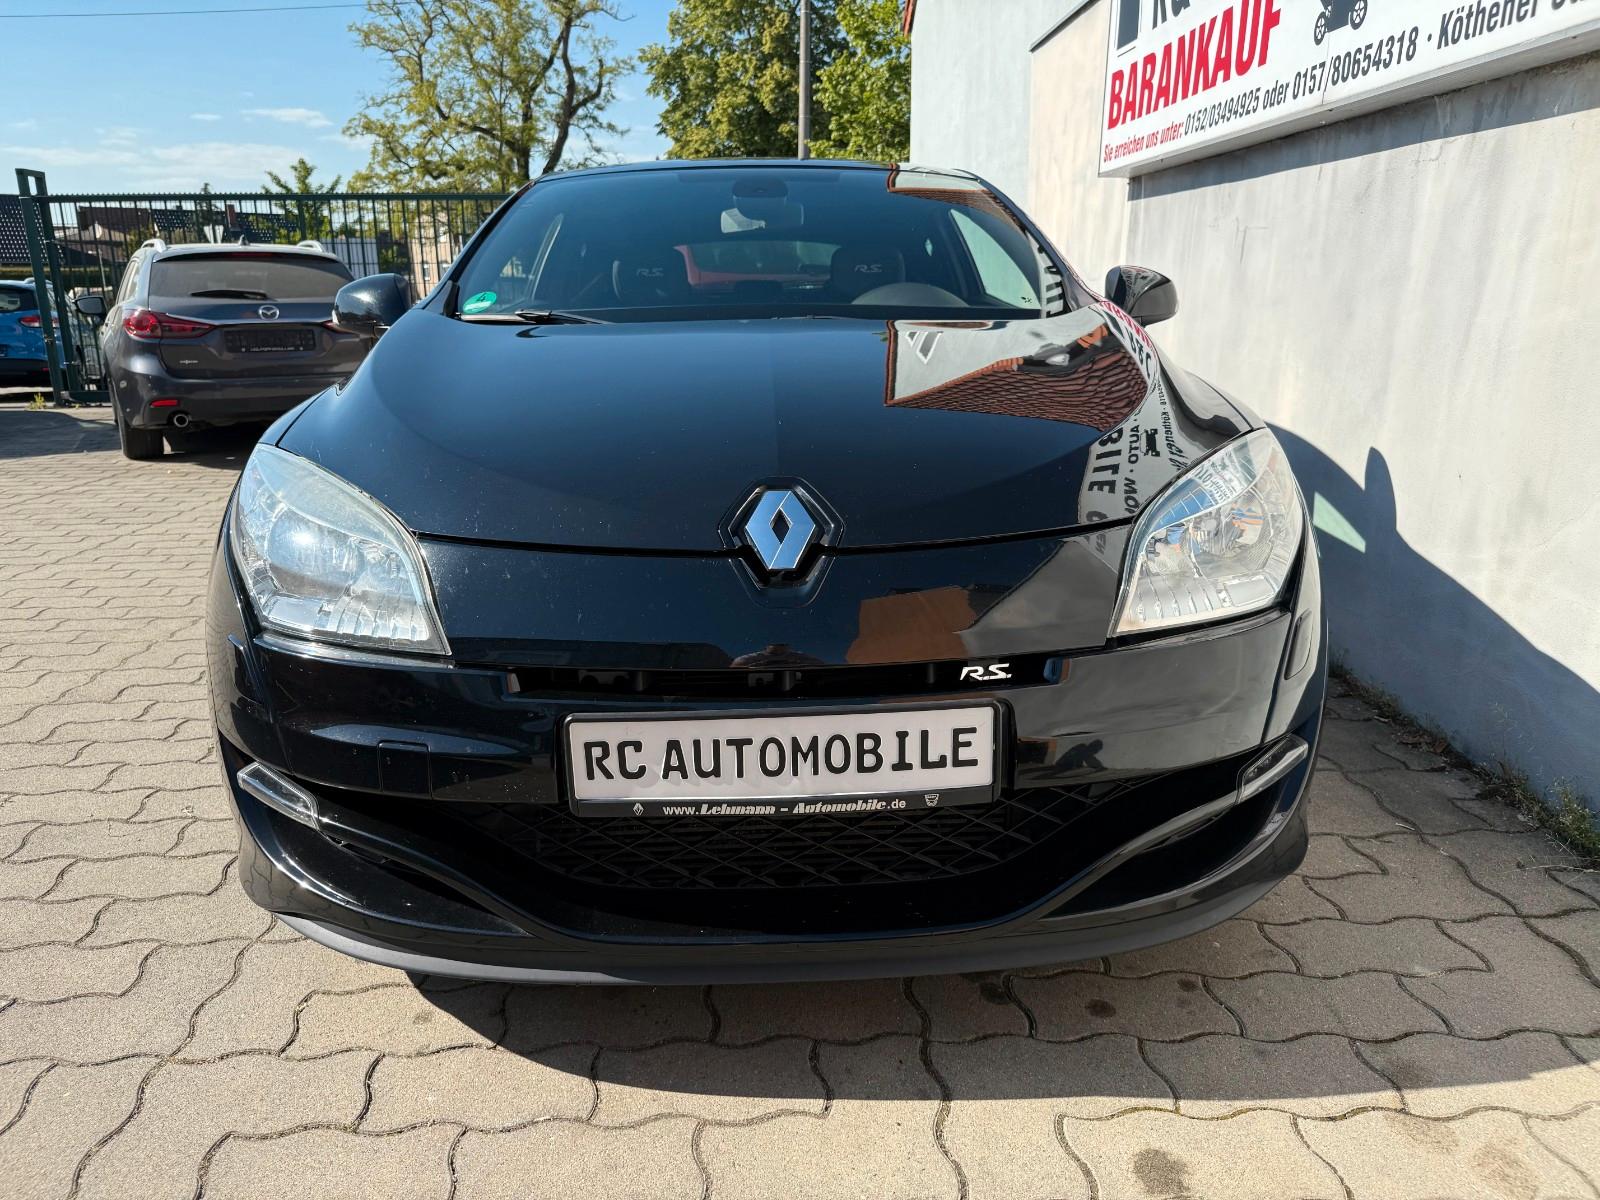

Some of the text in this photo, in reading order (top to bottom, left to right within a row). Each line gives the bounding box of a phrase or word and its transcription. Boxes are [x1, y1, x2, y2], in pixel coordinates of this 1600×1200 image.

[1103, 143, 1113, 163] Sie
[1114, 134, 1145, 159] erreichen
[1145, 130, 1159, 149] uns
[1160, 121, 1185, 145] unter:
[1184, 86, 1261, 136] 0152/03494925
[1262, 80, 1291, 111] oder
[1292, 26, 1419, 100] 0157/80654318
[1107, 0, 1281, 129] BARANKAUF
[583, 726, 980, 782] RC AUTOMOBILE
[663, 802, 776, 816] www.Lehmann
[792, 798, 907, 814] Automobile.de
